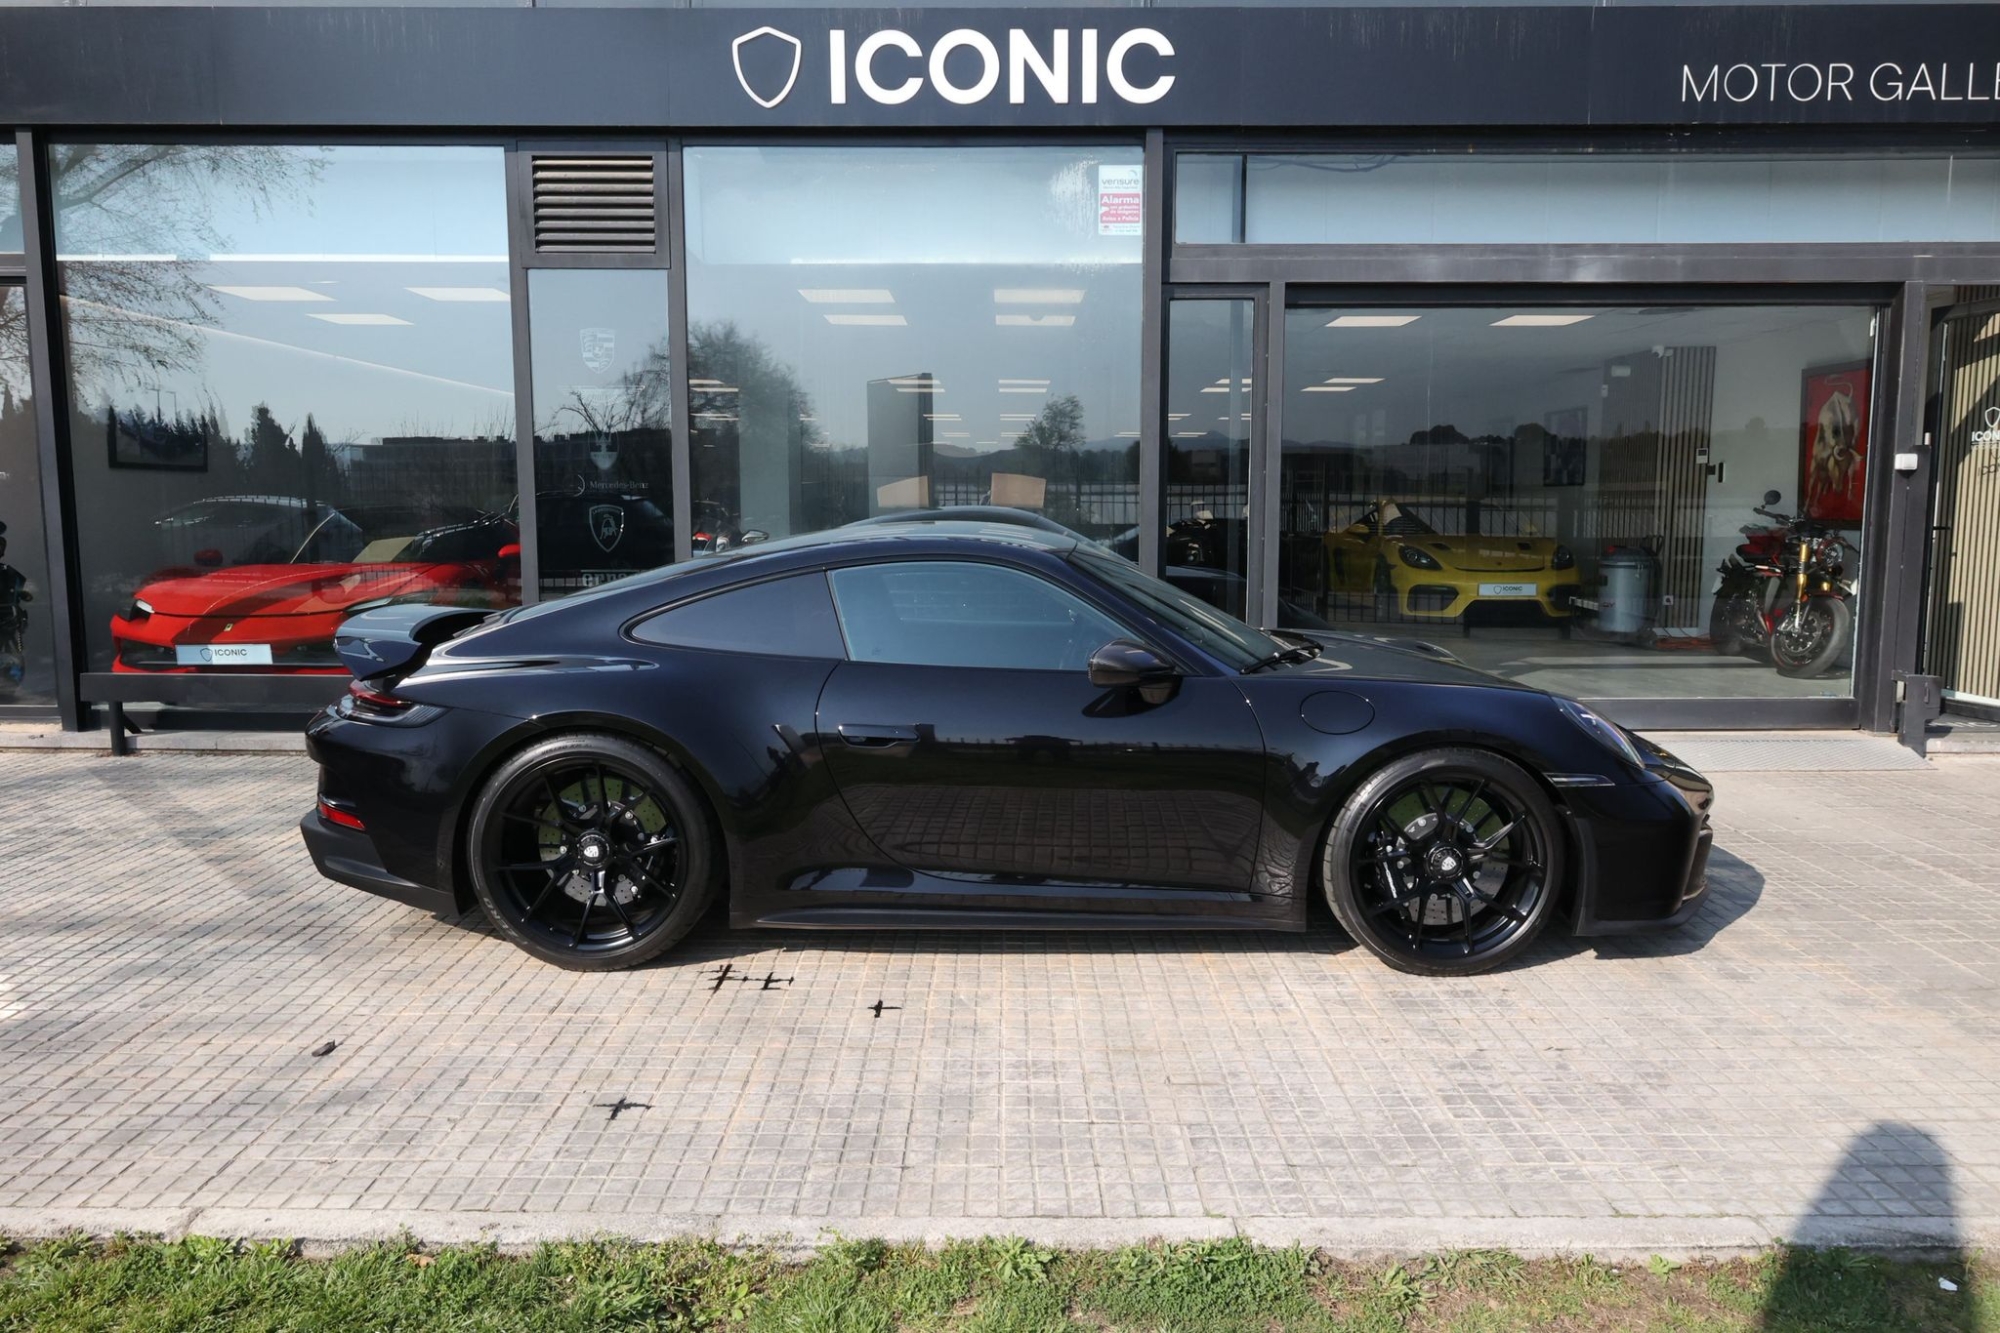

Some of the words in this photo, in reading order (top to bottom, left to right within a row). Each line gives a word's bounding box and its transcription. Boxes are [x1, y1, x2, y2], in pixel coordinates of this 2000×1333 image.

[830, 28, 1176, 105] ICONIC
[1682, 63, 1854, 102] MOTOR
[1870, 62, 2000, 101] GALL
[1101, 195, 1139, 204] Alarma
[589, 480, 649, 489] Mercedes-Benz
